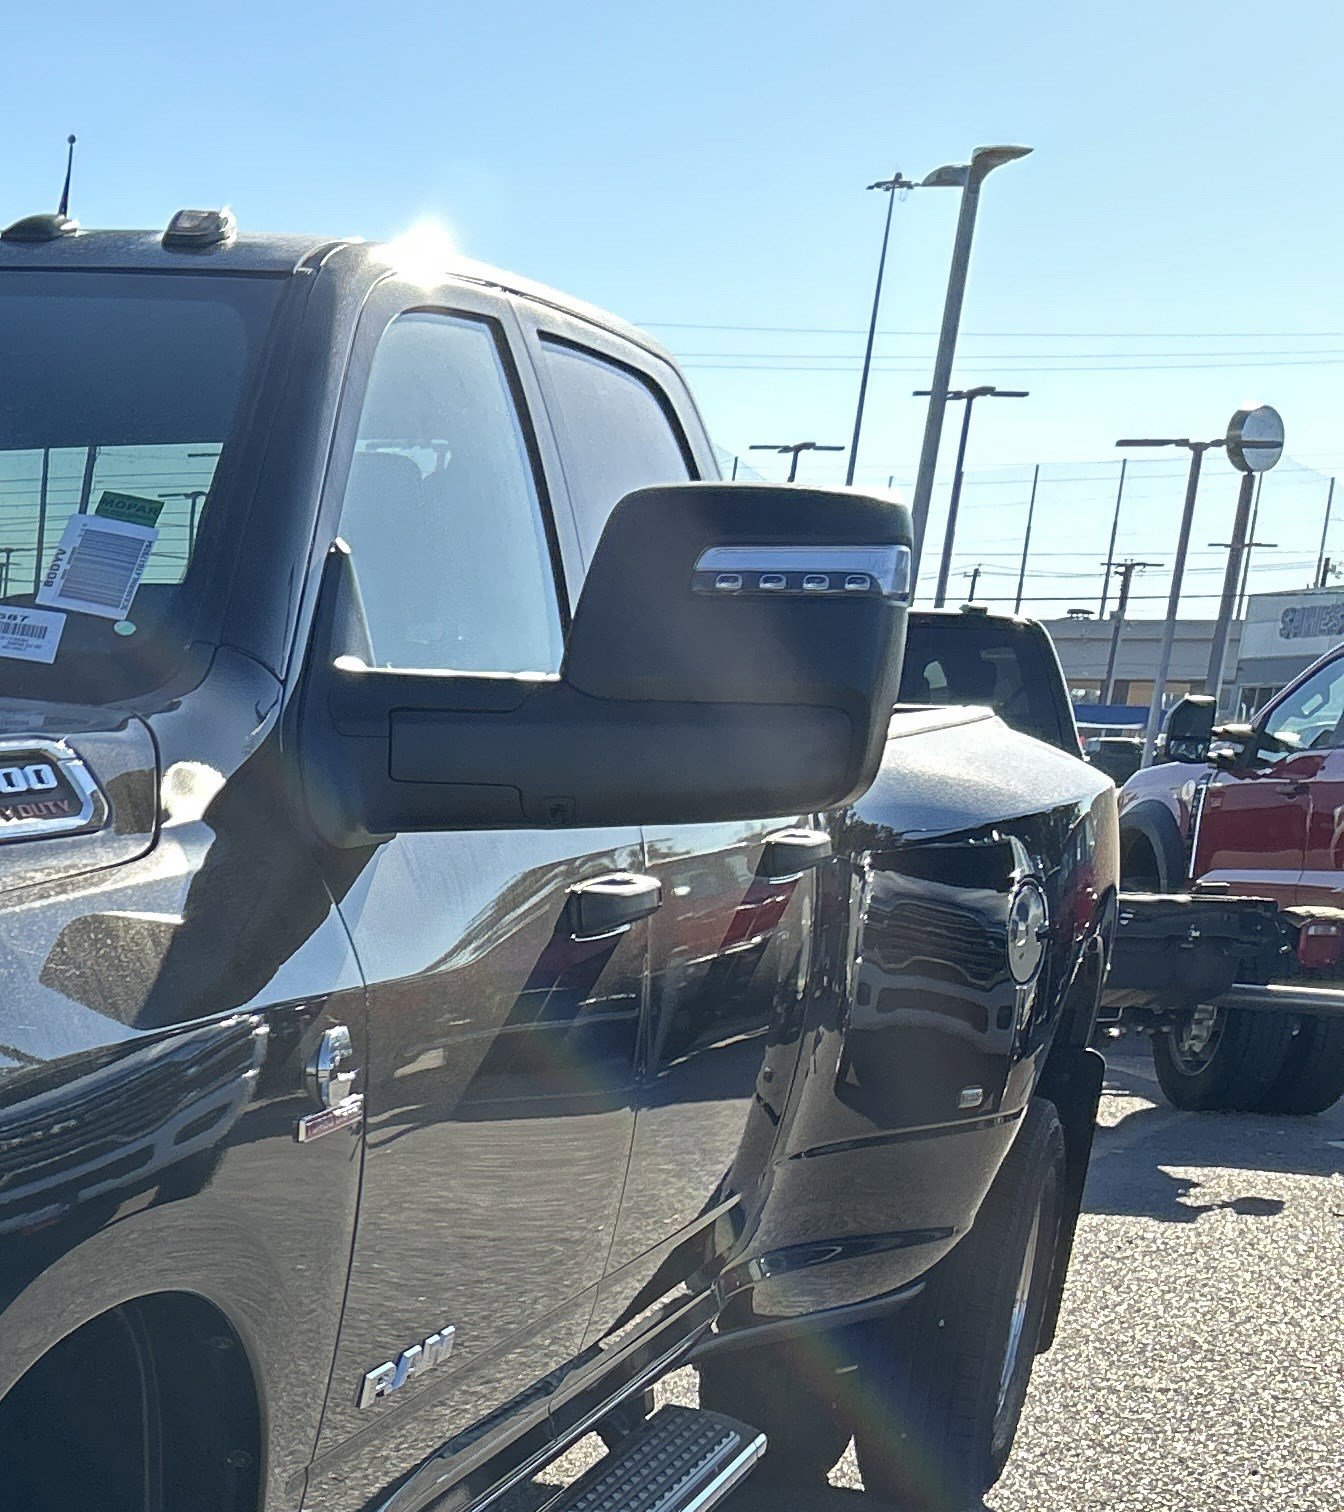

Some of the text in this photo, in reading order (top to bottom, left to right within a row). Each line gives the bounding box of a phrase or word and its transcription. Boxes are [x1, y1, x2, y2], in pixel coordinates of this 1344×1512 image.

[102, 498, 160, 516] MOPAR
[43, 548, 67, 588] BODYV
[16, 799, 69, 818] DUTY
[357, 1325, 456, 1409] RAM
